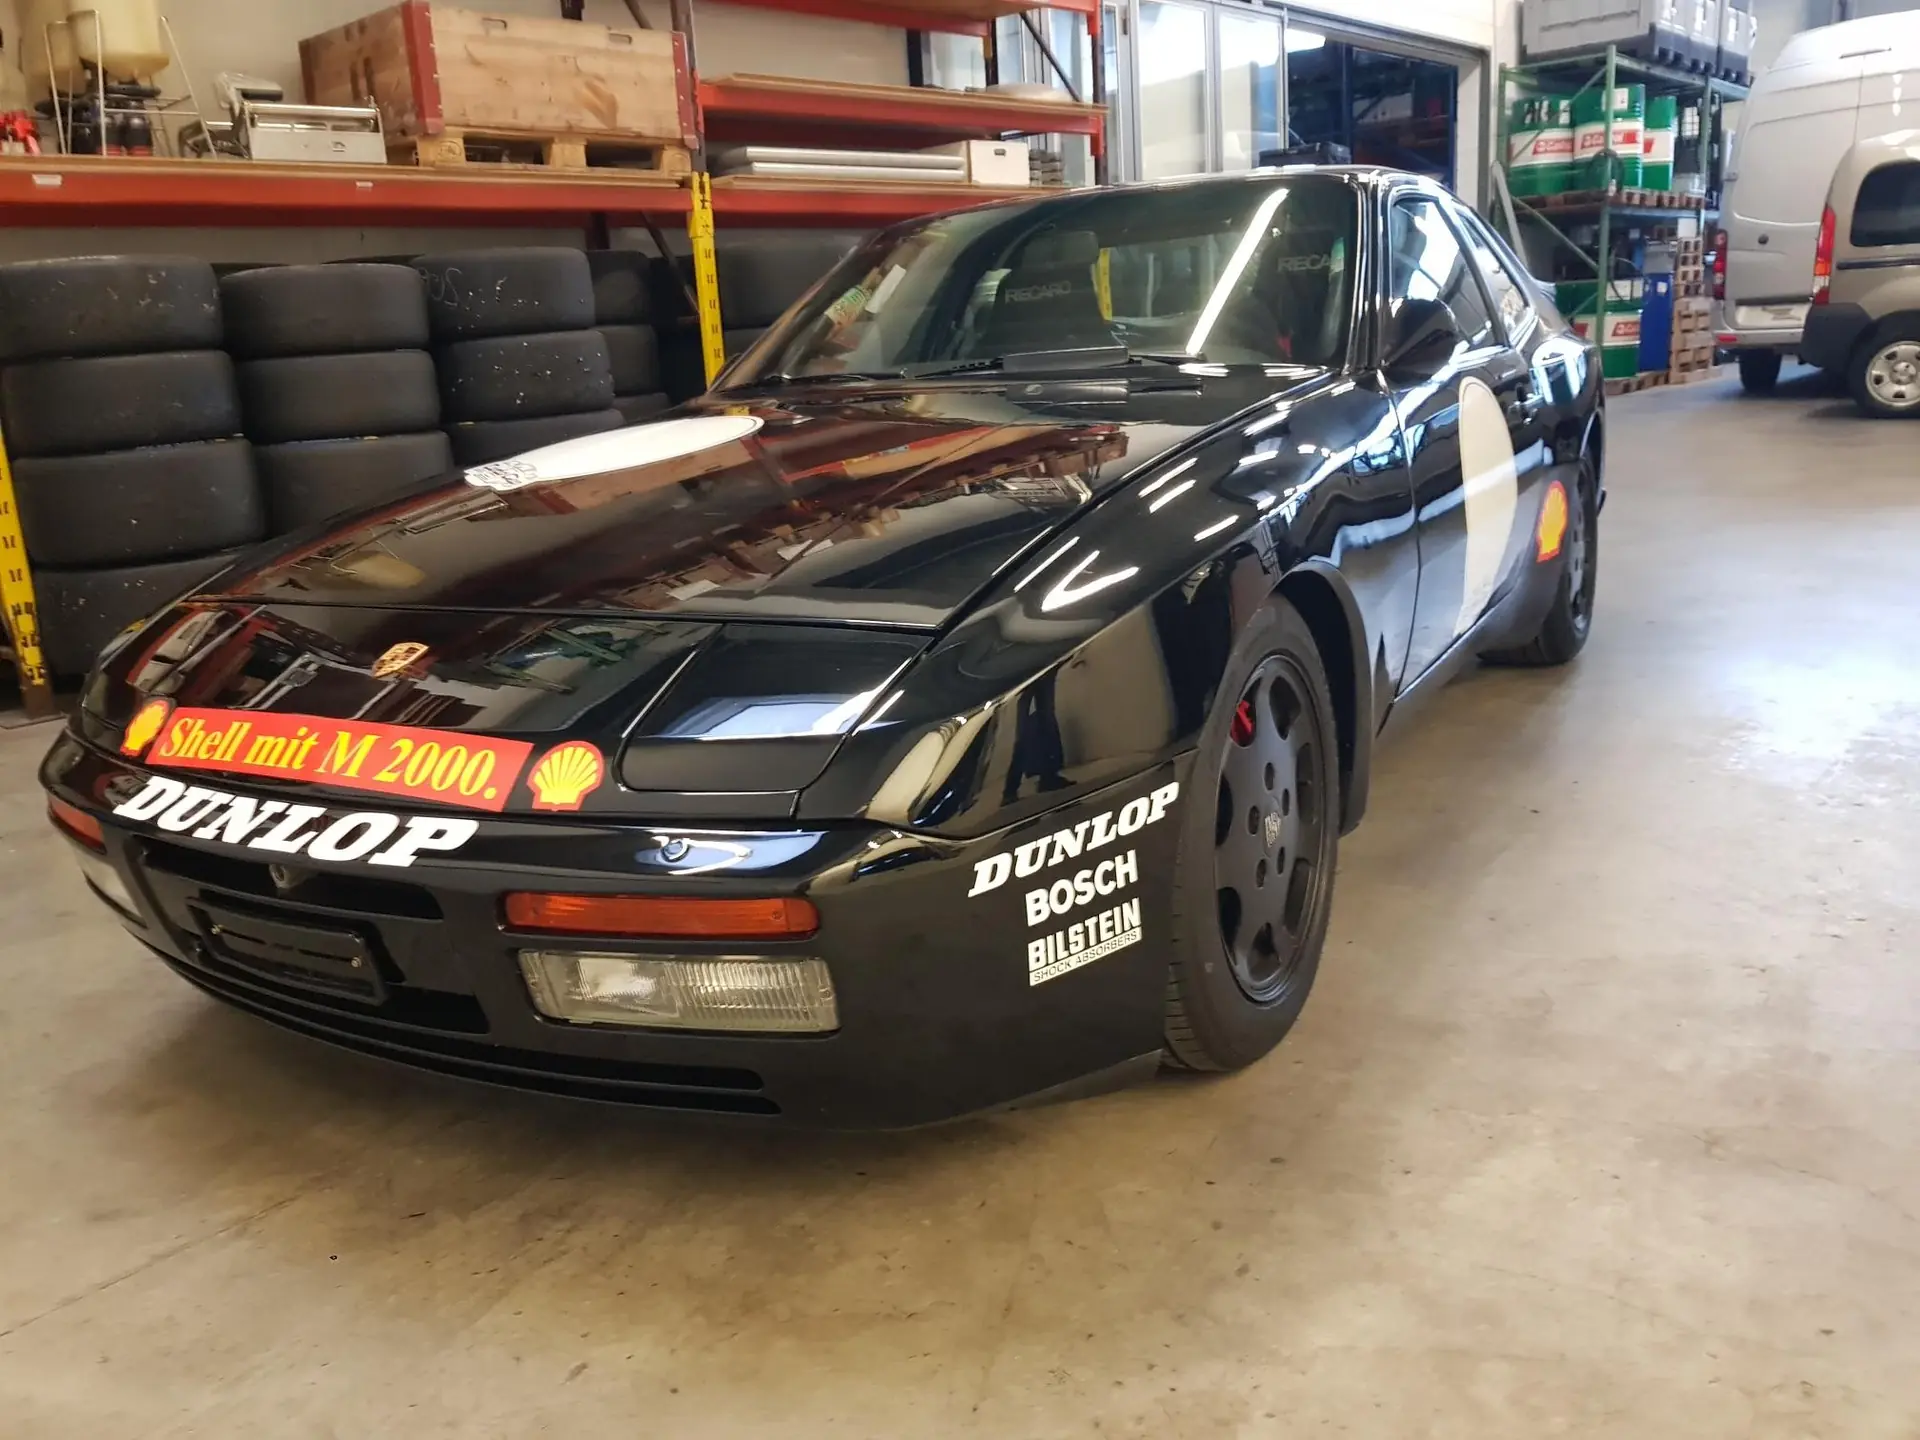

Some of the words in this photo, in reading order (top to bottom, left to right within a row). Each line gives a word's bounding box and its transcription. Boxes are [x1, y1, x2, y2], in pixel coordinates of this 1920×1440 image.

[1005, 281, 1071, 304] RECARO
[1277, 253, 1332, 272] RECA
[160, 717, 252, 762] Shell
[244, 726, 320, 770] mit
[314, 731, 381, 779] M
[373, 739, 498, 800] 2000.
[112, 775, 479, 868] DUNLOP
[968, 781, 1180, 898] DUNLOP
[1025, 849, 1139, 927] BOSCH
[1028, 897, 1142, 972] BILSTEIN
[1033, 960, 1072, 983] SHOCK
[1075, 931, 1138, 965] ABSORBERS
